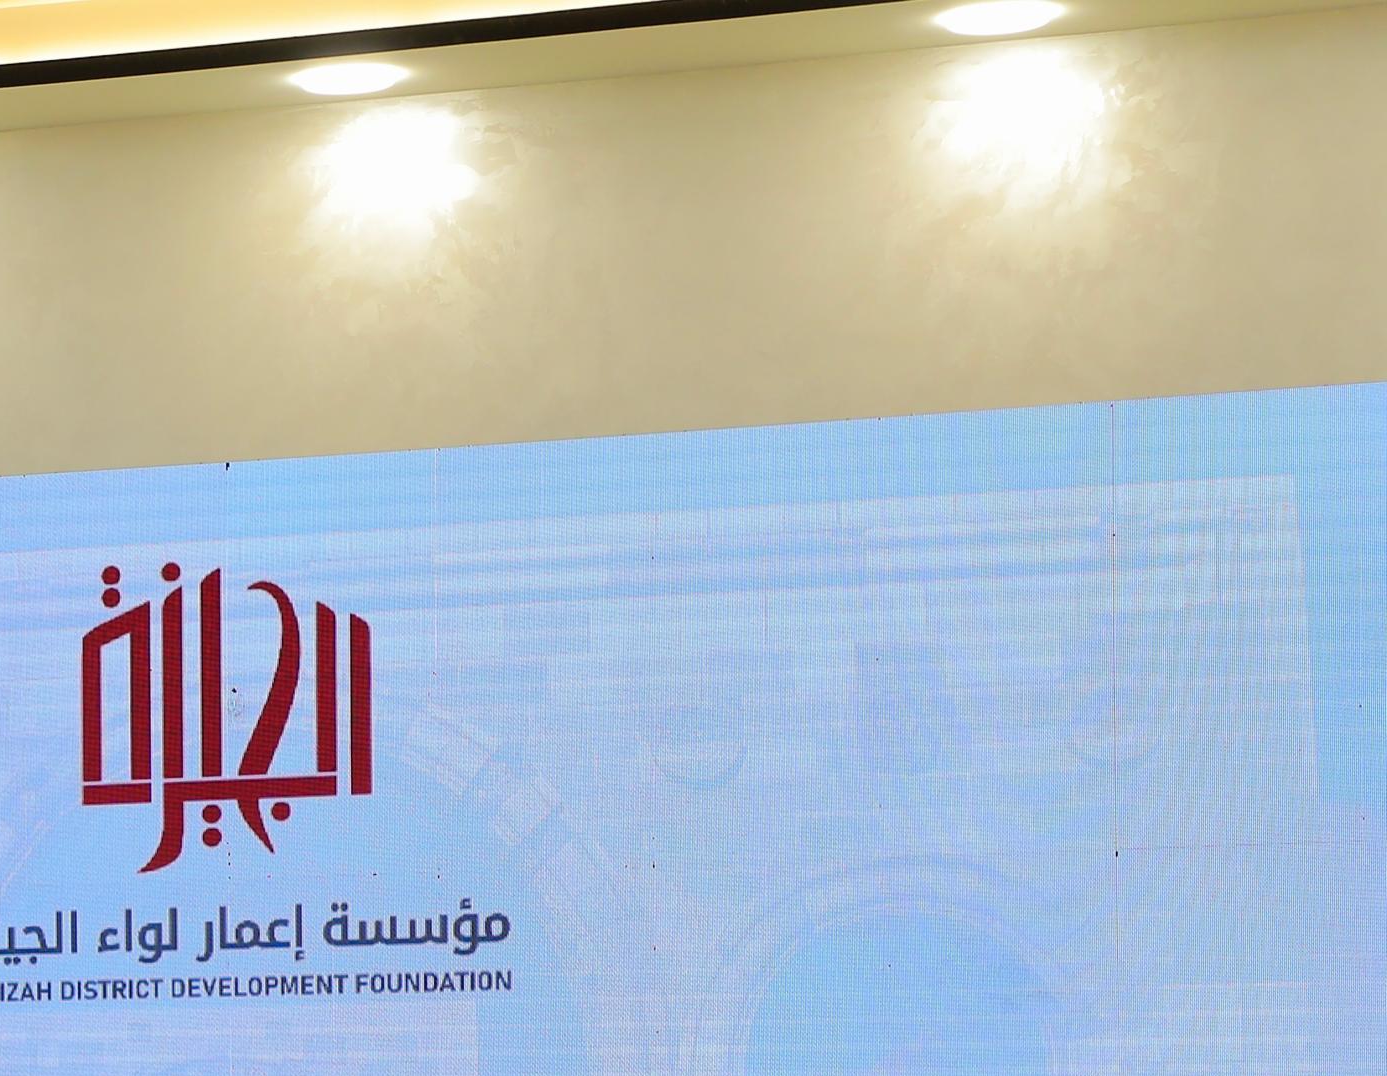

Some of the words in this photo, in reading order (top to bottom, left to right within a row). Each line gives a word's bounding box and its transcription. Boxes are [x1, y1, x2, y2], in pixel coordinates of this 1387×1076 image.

[98, 908, 177, 963] لواء
[196, 904, 304, 962] إعمار
[323, 898, 510, 955] مؤسسة
[62, 979, 163, 1000] DISTRICT
[172, 975, 348, 997] DEVELOPMENT
[356, 971, 511, 993] FOUNDATION
